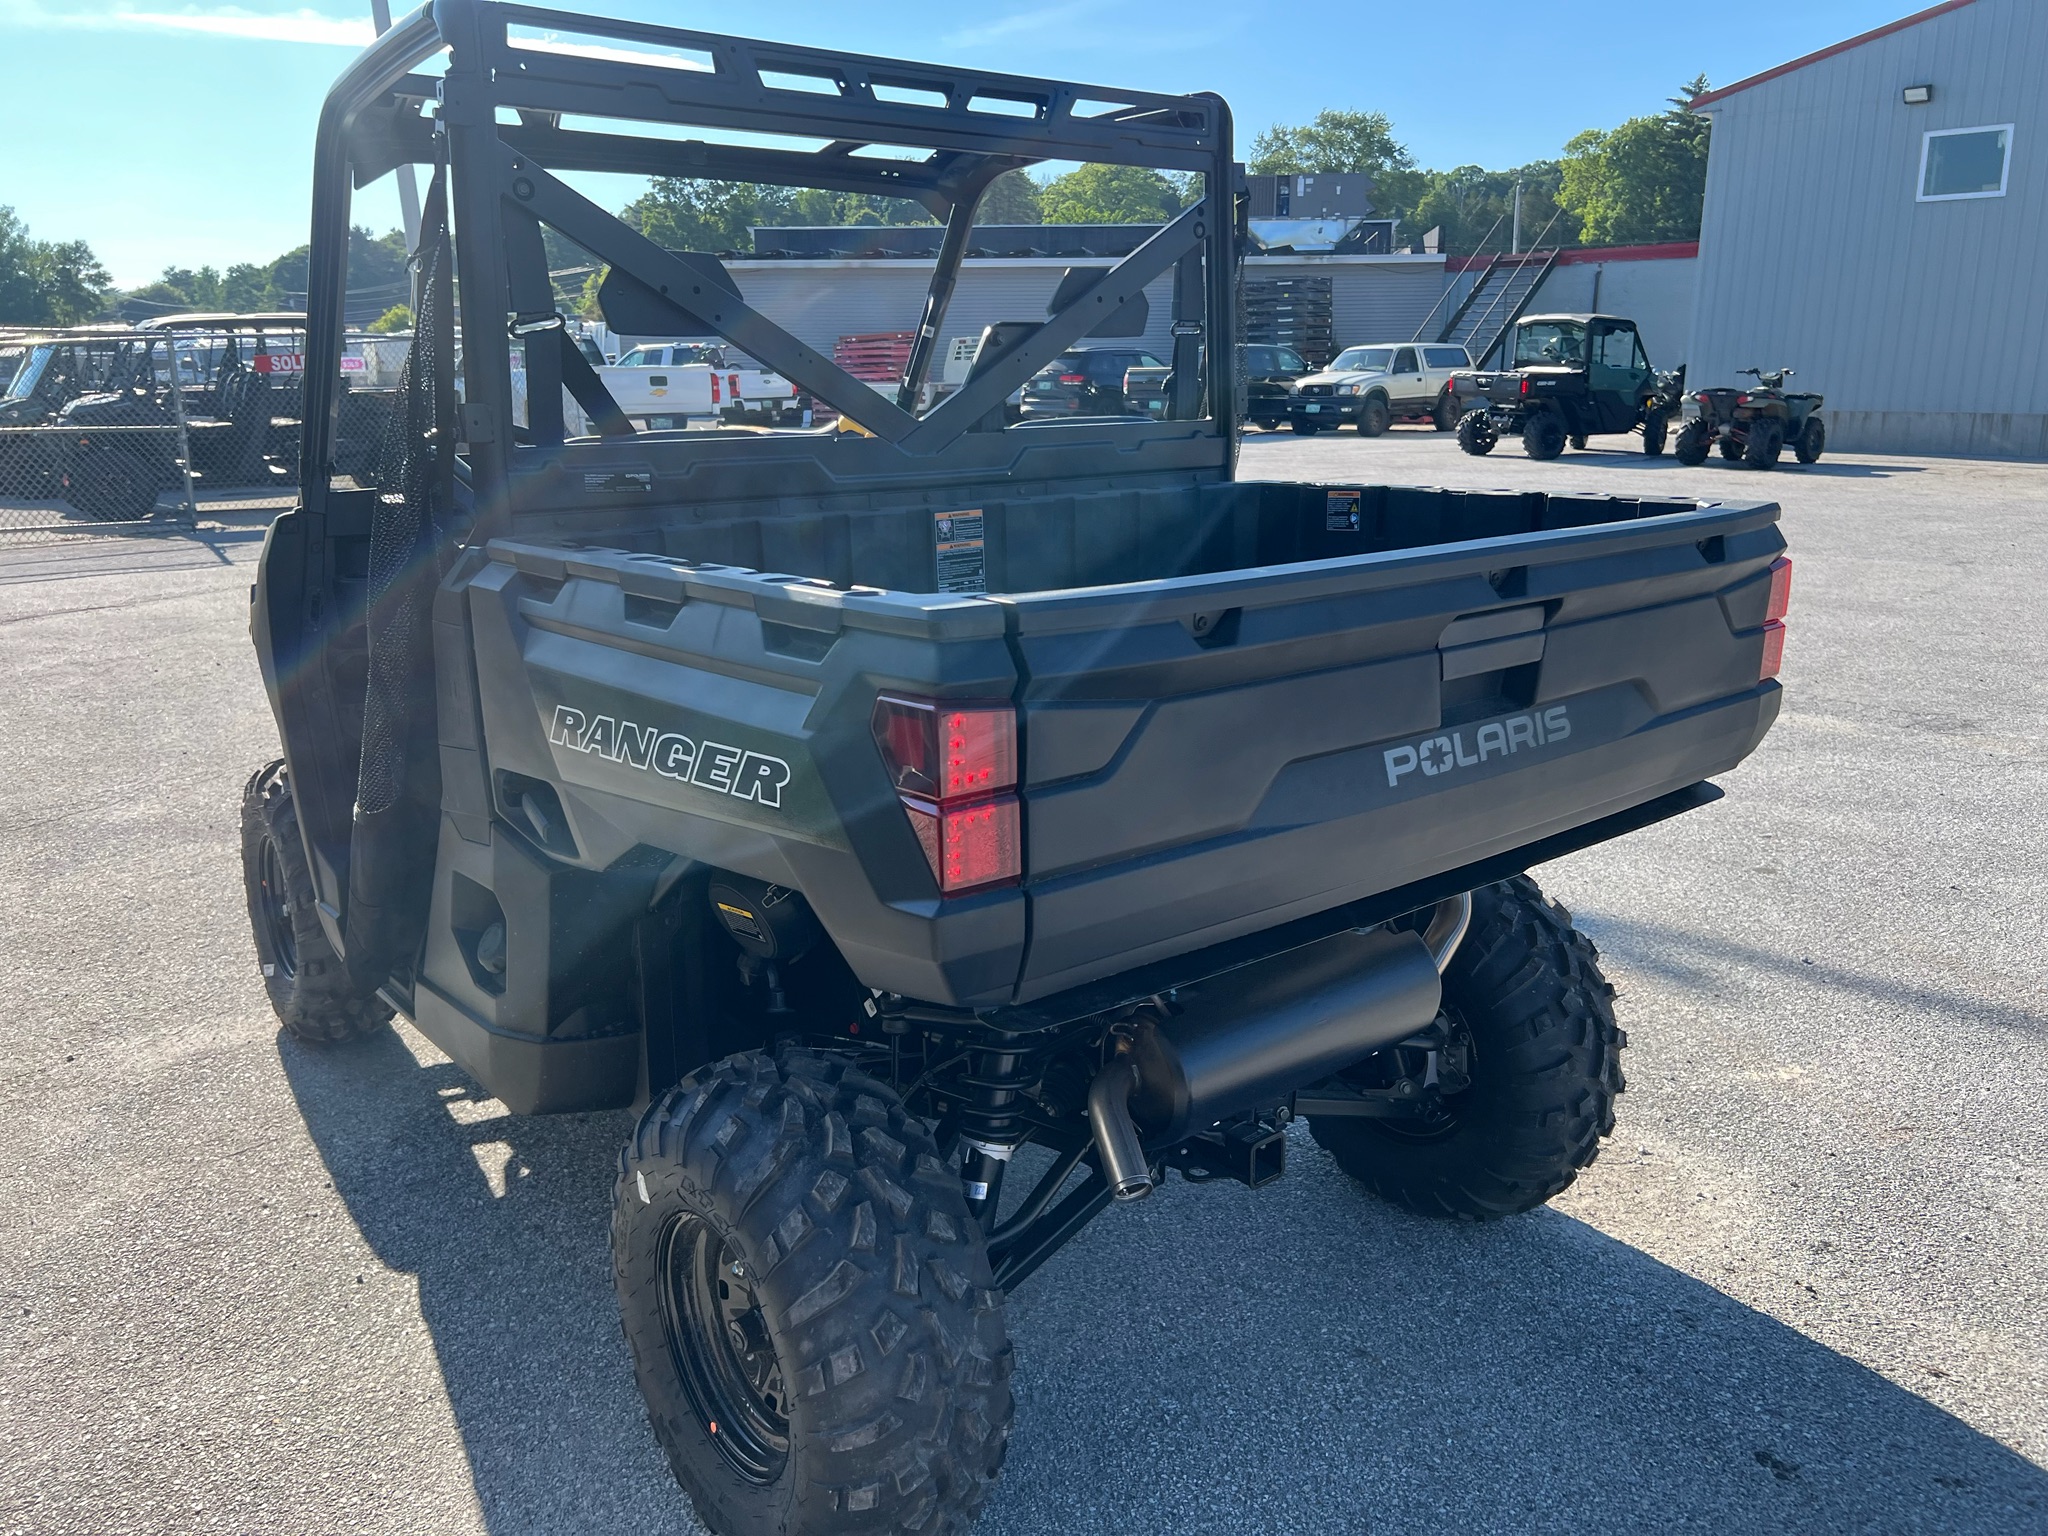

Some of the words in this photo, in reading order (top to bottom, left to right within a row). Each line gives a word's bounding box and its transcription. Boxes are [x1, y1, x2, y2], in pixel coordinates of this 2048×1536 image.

[270, 355, 305, 371] SOL
[550, 704, 791, 808] RANGER
[1383, 705, 1572, 788] POLARIS
